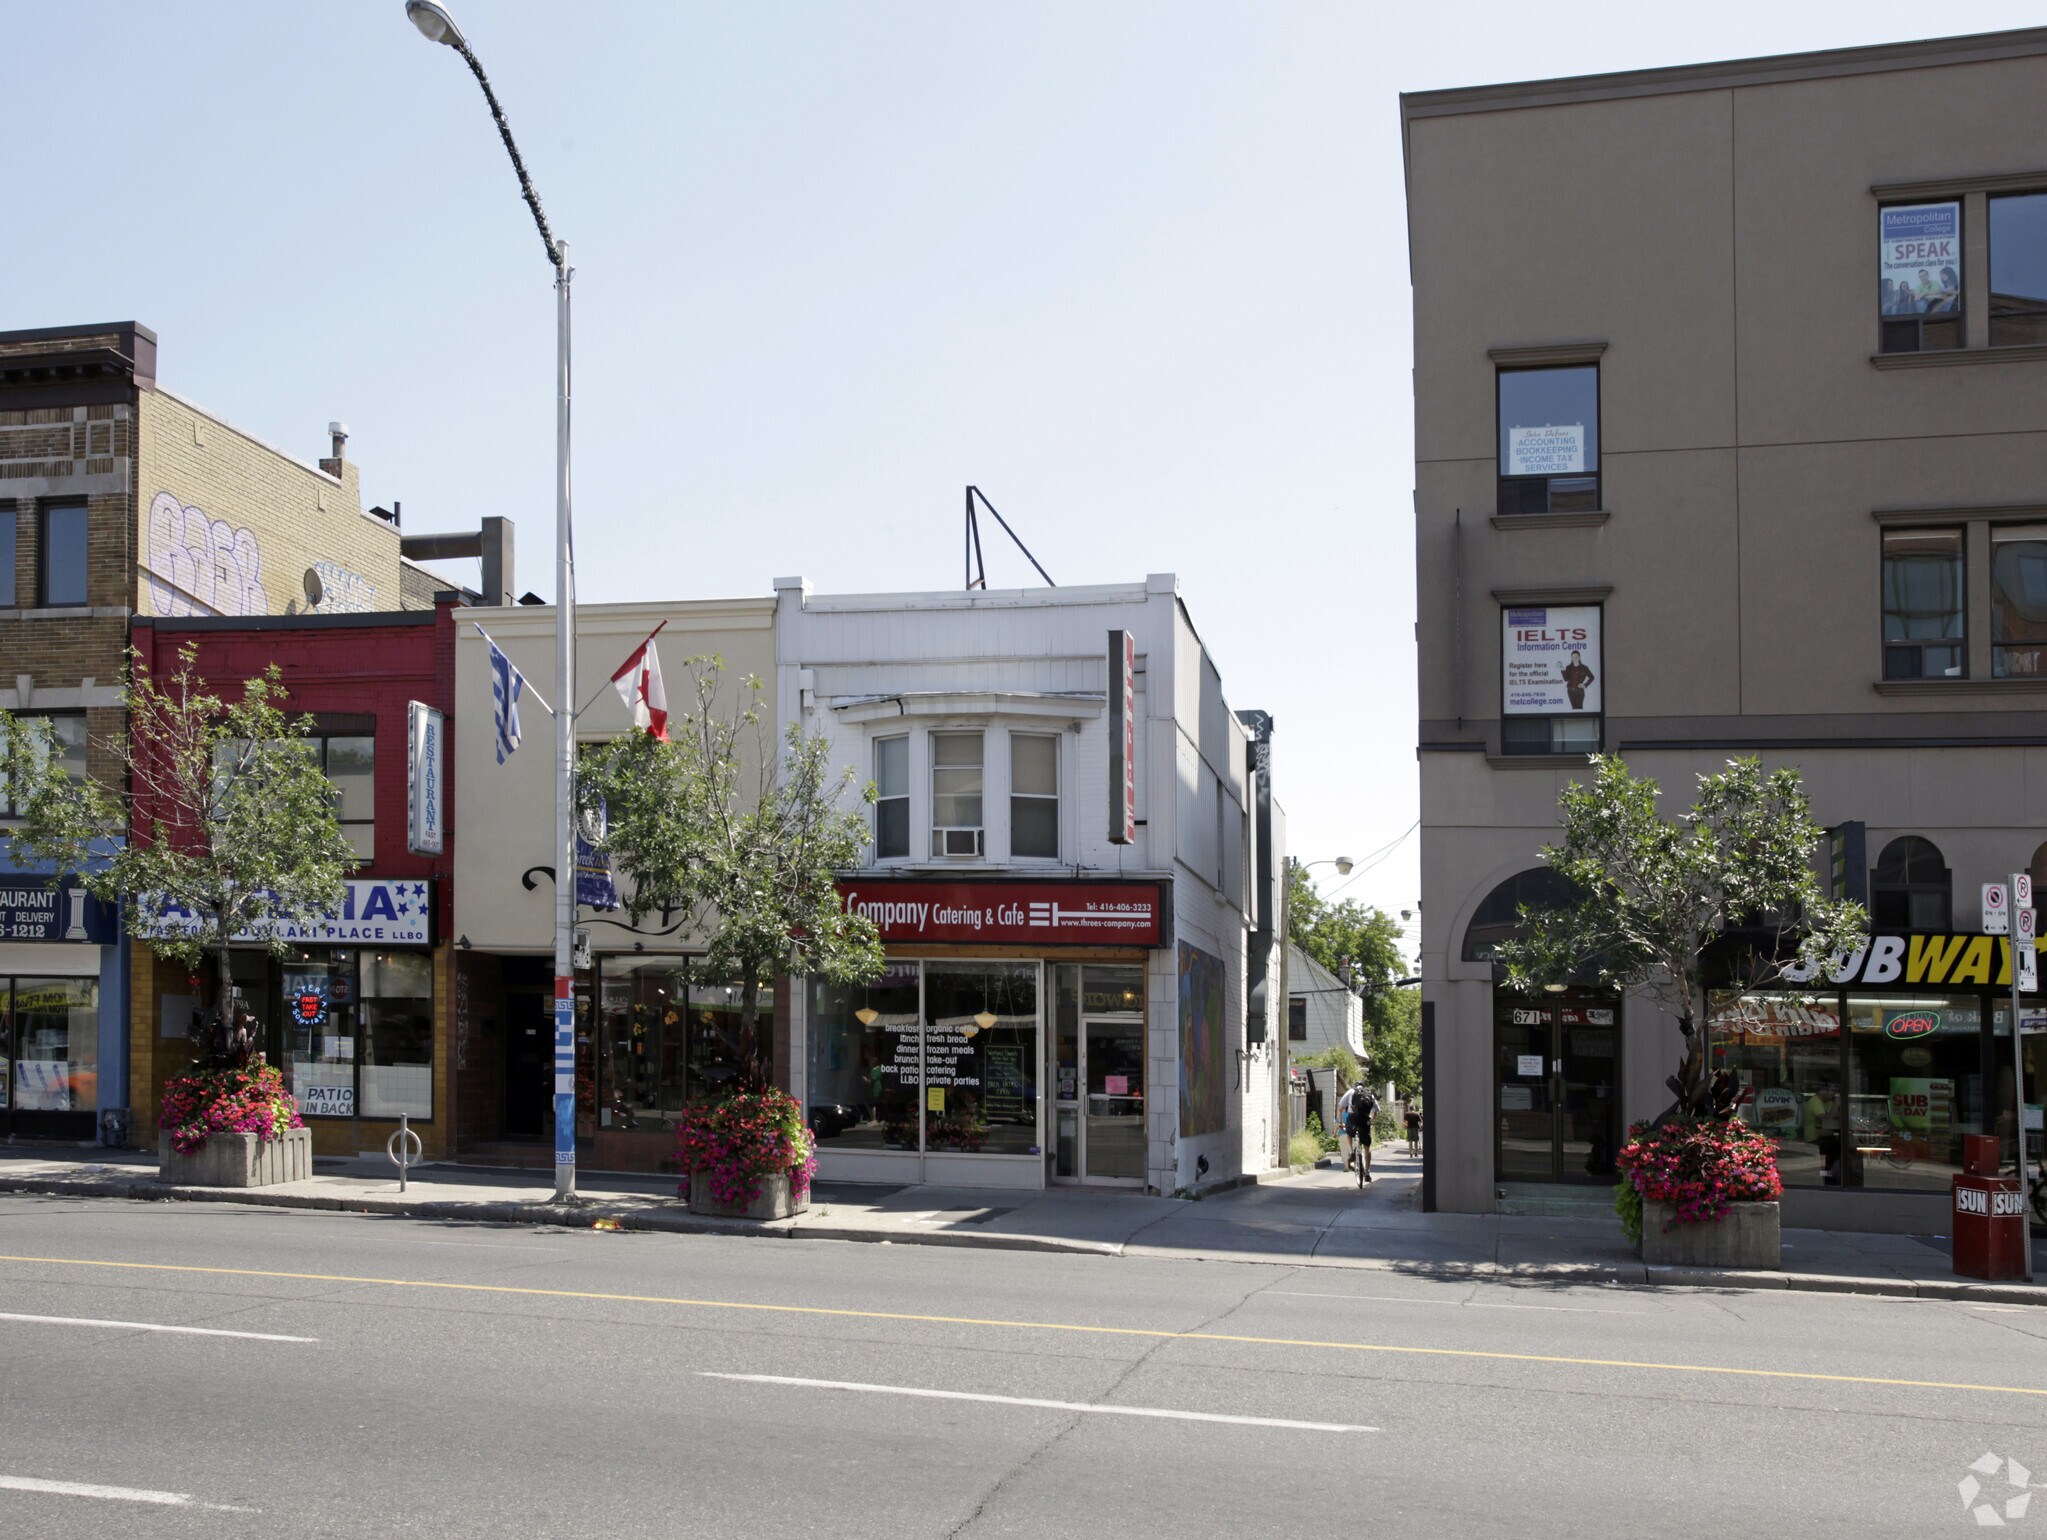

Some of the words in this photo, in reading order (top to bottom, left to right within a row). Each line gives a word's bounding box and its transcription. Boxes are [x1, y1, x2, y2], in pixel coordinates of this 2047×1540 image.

[1886, 212, 1951, 224] Metropolitan
[1893, 260, 1925, 269] conversation
[1925, 258, 1937, 266] class
[1937, 257, 1945, 265] for
[1518, 437, 1576, 447] ACCOUNTING
[1516, 445, 1578, 455] BOOKKEEPING
[1520, 455, 1554, 463] INCOME
[1556, 454, 1574, 462] TAX
[1524, 463, 1568, 472] SERVICES
[1517, 629, 1587, 641] IELTS
[1517, 642, 1560, 651] Information
[1562, 641, 1587, 650] Centre
[1510, 698, 1564, 706] metcollege.com
[425, 724, 436, 831] RESTAURANT
[425, 830, 437, 839] FAST
[1086, 902, 1098, 911] Tel:
[1100, 902, 1152, 912] 416-406-3233
[16, 911, 55, 923] DELIVERY
[932, 904, 983, 930] Catering
[985, 907, 994, 923] &
[998, 902, 1024, 927] Cafe
[1060, 918, 1152, 929] www.threes-company.com
[326, 926, 385, 939] PLACE
[392, 931, 424, 940] LLBO
[291, 984, 327, 1008] ASTERIA
[1514, 1011, 1539, 1024] 671
[885, 1024, 920, 1033] breakfast
[926, 1025, 952, 1034] organic
[954, 1025, 979, 1033] coffee
[1892, 1018, 1933, 1033] OPEN
[900, 1034, 919, 1043] lunch
[926, 1034, 945, 1043] fresh
[947, 1035, 969, 1043] bread
[896, 1045, 919, 1053] dinner
[926, 1045, 950, 1054] frozen
[951, 1045, 975, 1054] meals
[894, 1055, 919, 1063] brunch
[926, 1056, 957, 1064] take-out
[880, 1064, 898, 1073] back
[900, 1065, 919, 1076] patio
[926, 1066, 956, 1076] catering
[900, 1075, 919, 1084] LLBO
[926, 1076, 951, 1086] private
[953, 1076, 980, 1086] parties
[307, 1088, 353, 1101] PATIO
[1893, 1094, 1928, 1107] SUB
[305, 1102, 318, 1113] IN
[320, 1102, 353, 1115] BACK
[1904, 1107, 1928, 1116] DAY
[1960, 1189, 1986, 1213] SUN
[1996, 1193, 2023, 1214] SUN
